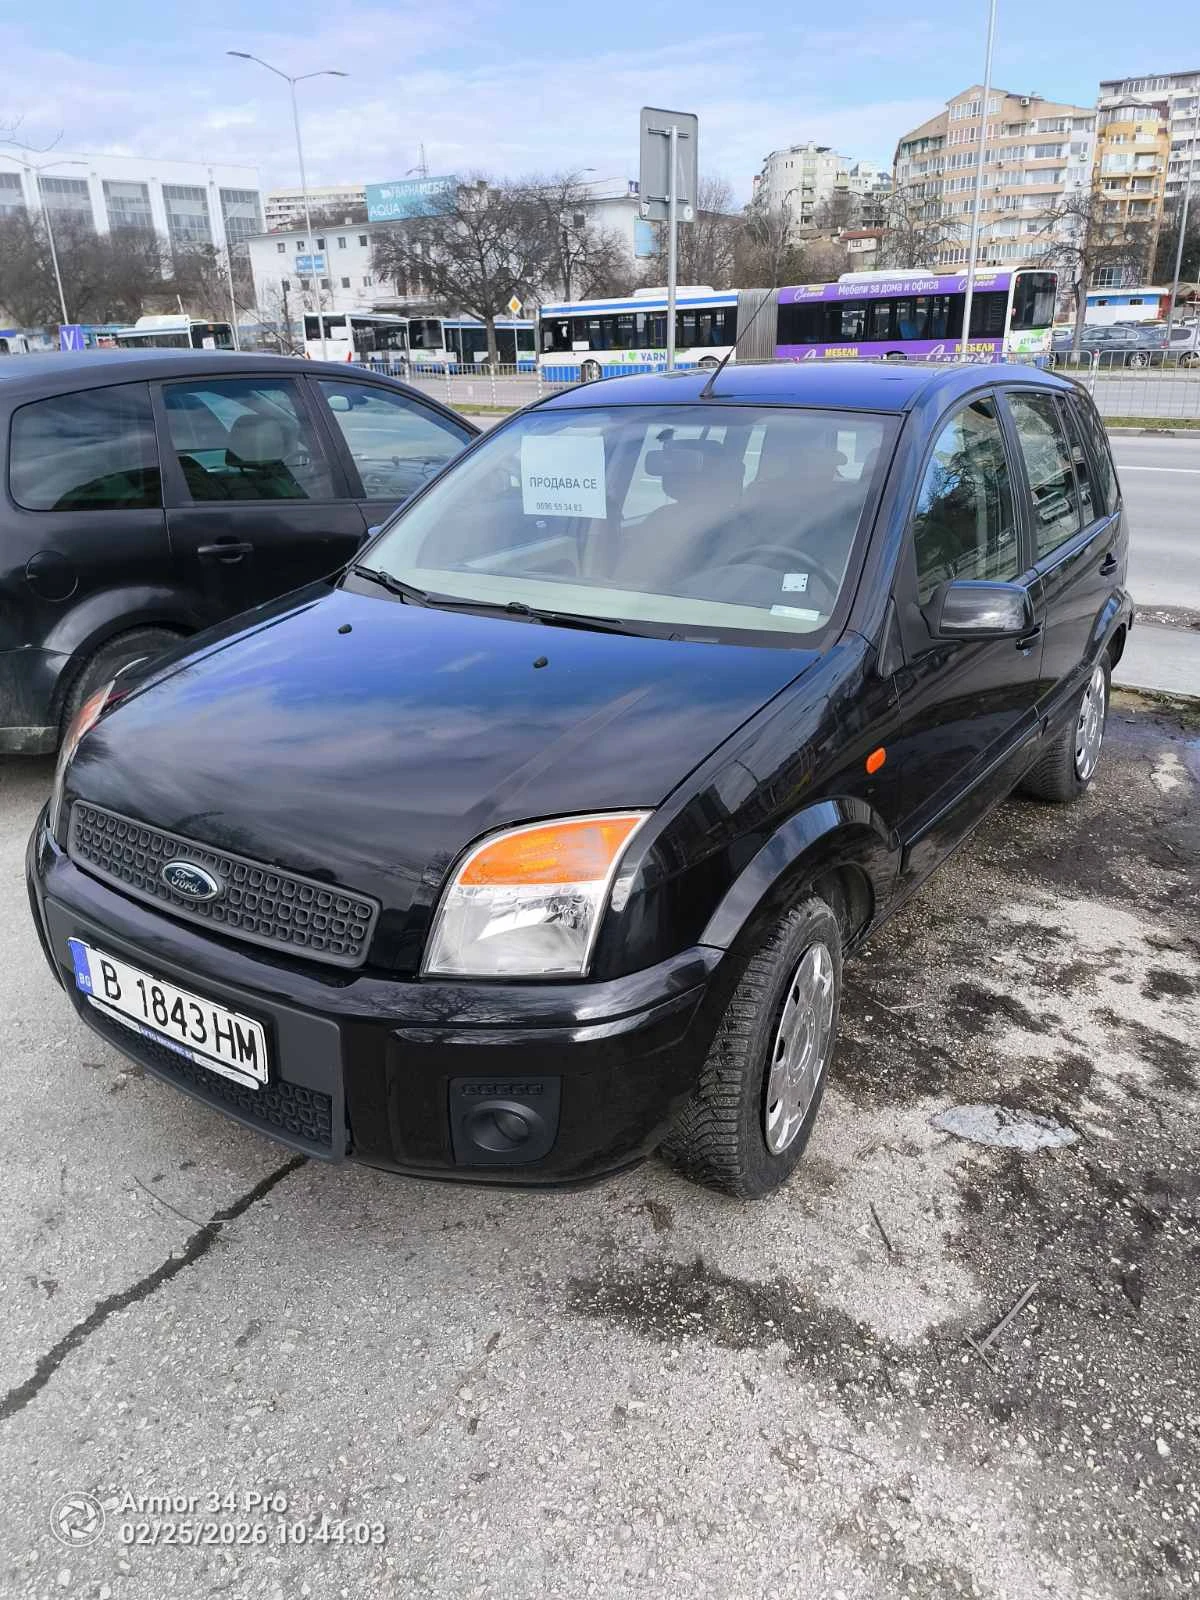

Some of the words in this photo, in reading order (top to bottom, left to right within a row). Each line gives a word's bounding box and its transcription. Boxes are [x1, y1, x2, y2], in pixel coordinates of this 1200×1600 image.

[838, 284, 869, 296] Мебели
[870, 284, 880, 293] за
[880, 282, 903, 294] дома
[911, 279, 939, 292] офиса
[530, 477, 580, 491] ПРОДАВА
[583, 478, 598, 489] СЕ
[172, 869, 201, 893] Ford
[100, 959, 122, 1001] B
[136, 978, 207, 1044] 1843
[212, 1011, 258, 1071] HM
